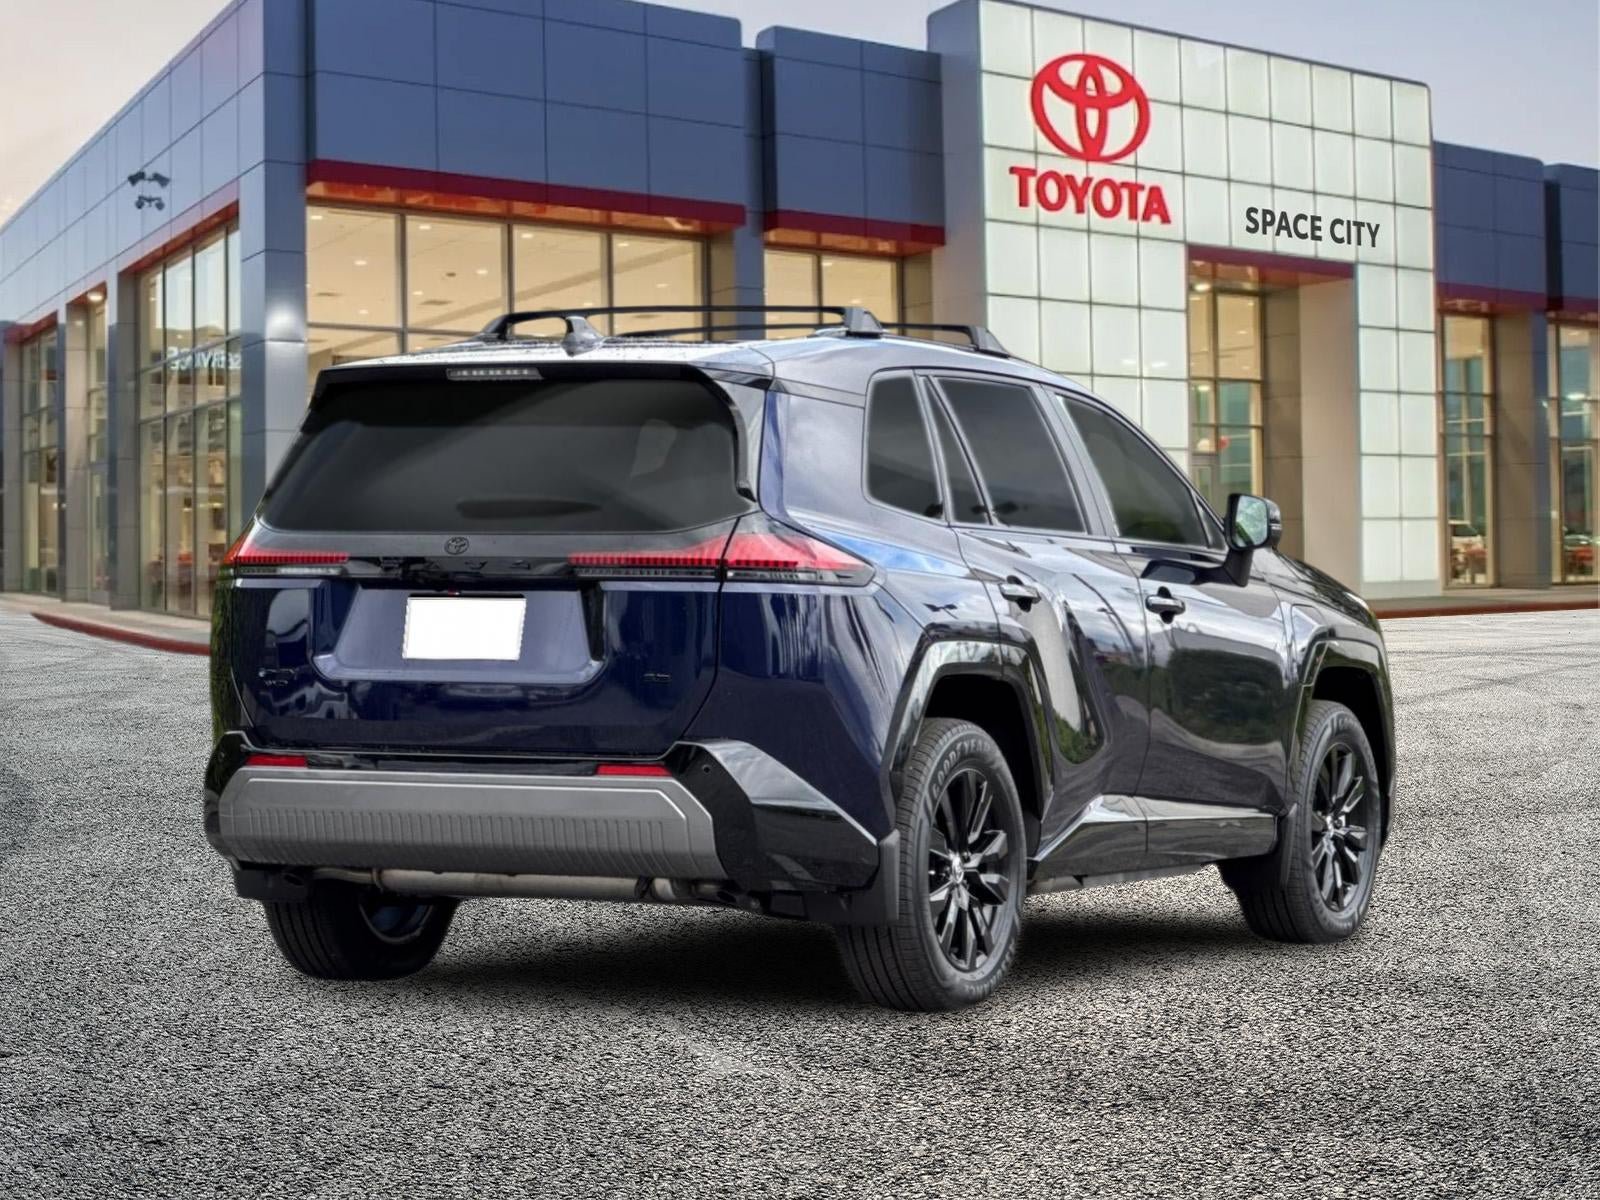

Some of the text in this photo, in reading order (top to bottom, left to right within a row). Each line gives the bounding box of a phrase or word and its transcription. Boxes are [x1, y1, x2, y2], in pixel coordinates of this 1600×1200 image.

[1009, 166, 1172, 225] TOYOTA
[1245, 206, 1381, 248] SPACE CITY
